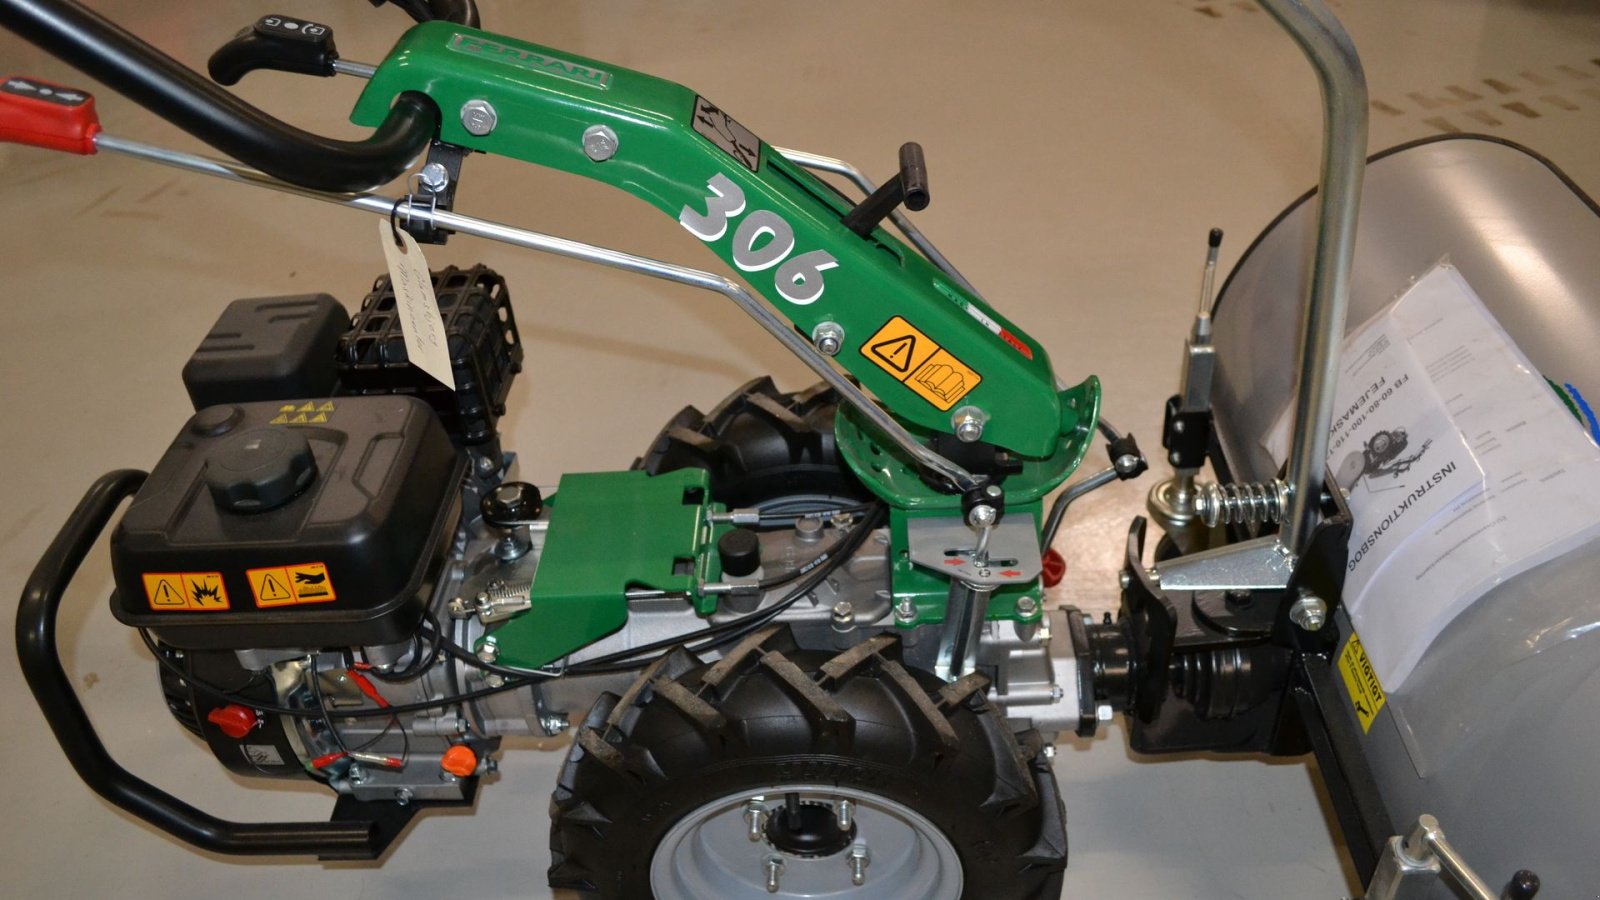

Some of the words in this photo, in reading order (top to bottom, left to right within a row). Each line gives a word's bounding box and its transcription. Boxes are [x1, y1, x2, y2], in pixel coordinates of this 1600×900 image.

[455, 36, 606, 84] FERRARI
[679, 172, 839, 305] 306
[1330, 376, 1386, 437] FEJEMASK
[1394, 373, 1409, 389] FB
[1348, 461, 1457, 572] INSTRUKTIONSBOG
[1359, 651, 1382, 702] VIGTIGT
